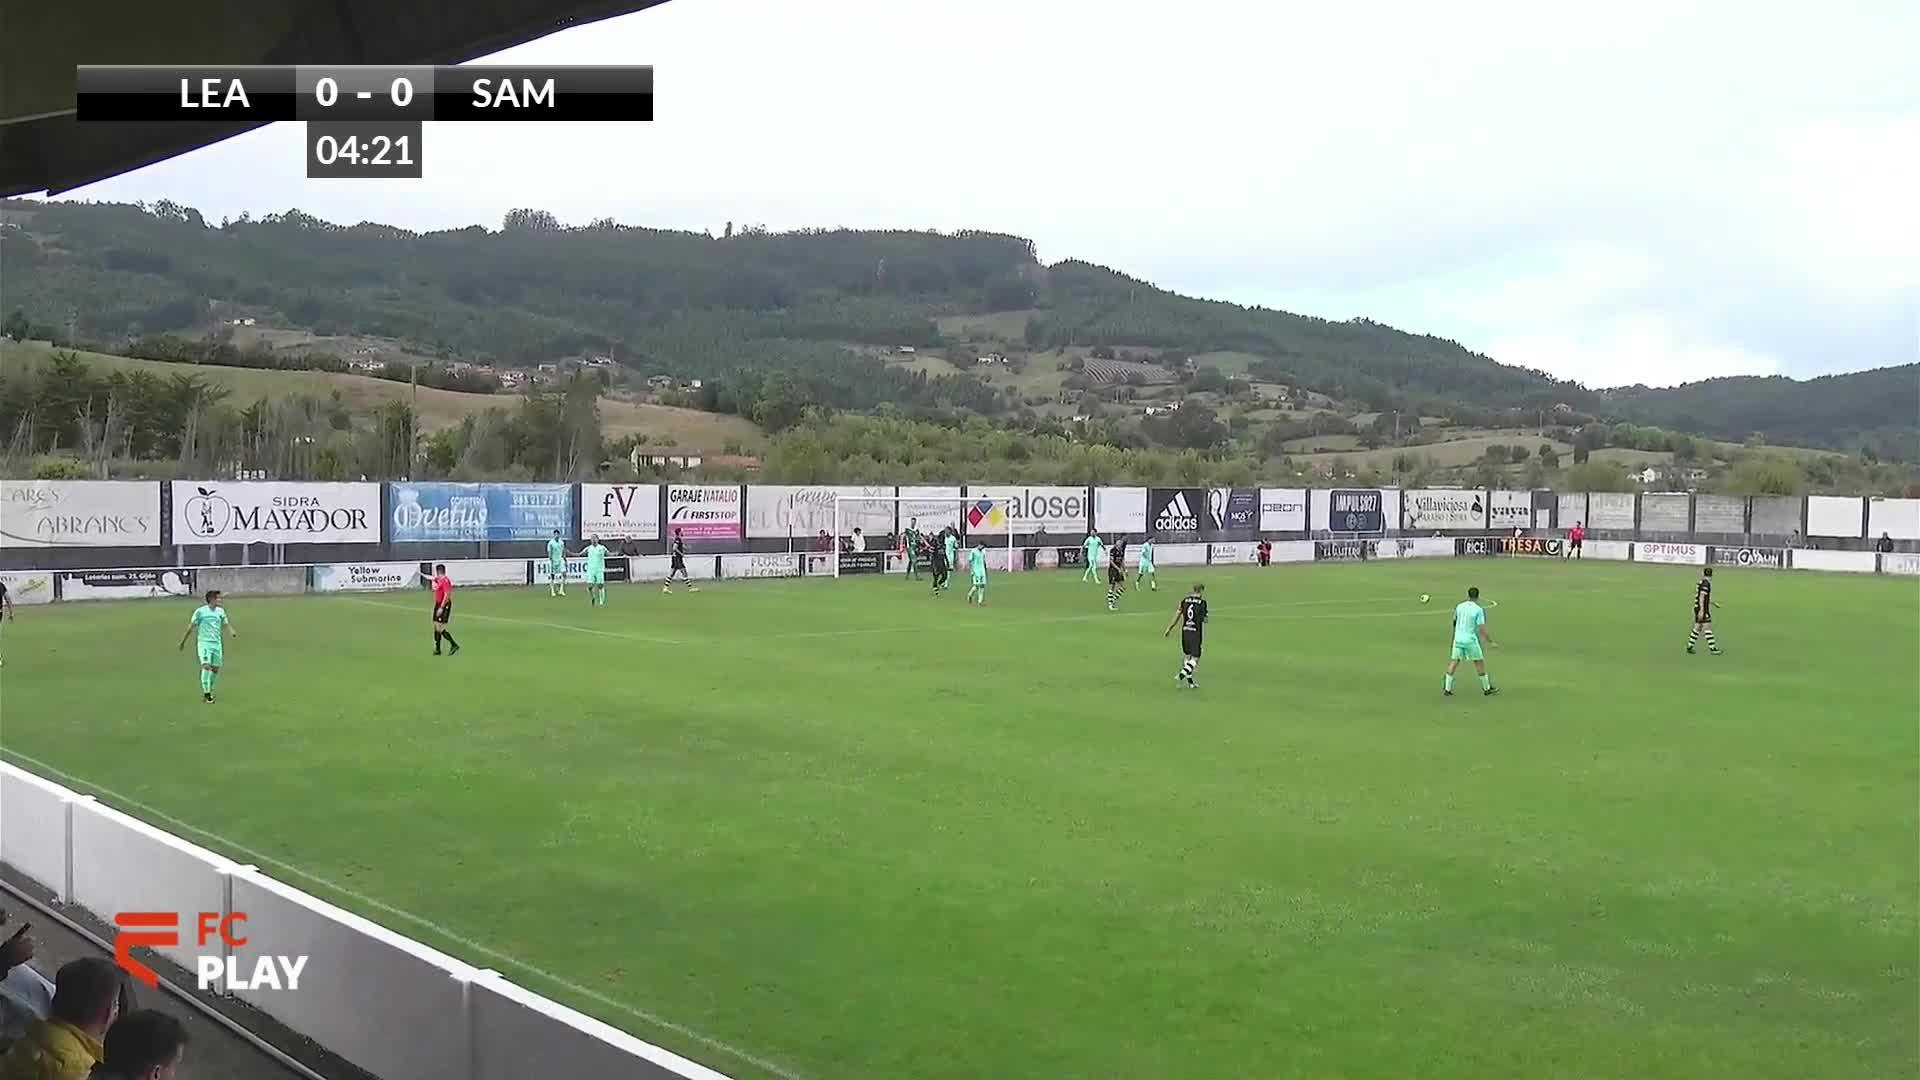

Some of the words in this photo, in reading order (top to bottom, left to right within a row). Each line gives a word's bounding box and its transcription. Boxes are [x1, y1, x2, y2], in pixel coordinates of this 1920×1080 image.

[273, 497, 320, 506] SIDRA
[602, 487, 638, 517] fV
[670, 489, 702, 503] GARAJE
[703, 490, 738, 503] NATALIO
[795, 488, 837, 504] Grupo
[1006, 489, 1086, 518] alosei
[232, 506, 367, 533] MAYADOR
[1155, 516, 1197, 530] adidas
[1502, 539, 1542, 552] TRESA
[1643, 543, 1696, 555] OPTIMUS
[348, 566, 380, 574] Yellow
[351, 575, 402, 583] Submarine
[1187, 604, 1194, 619] 6
